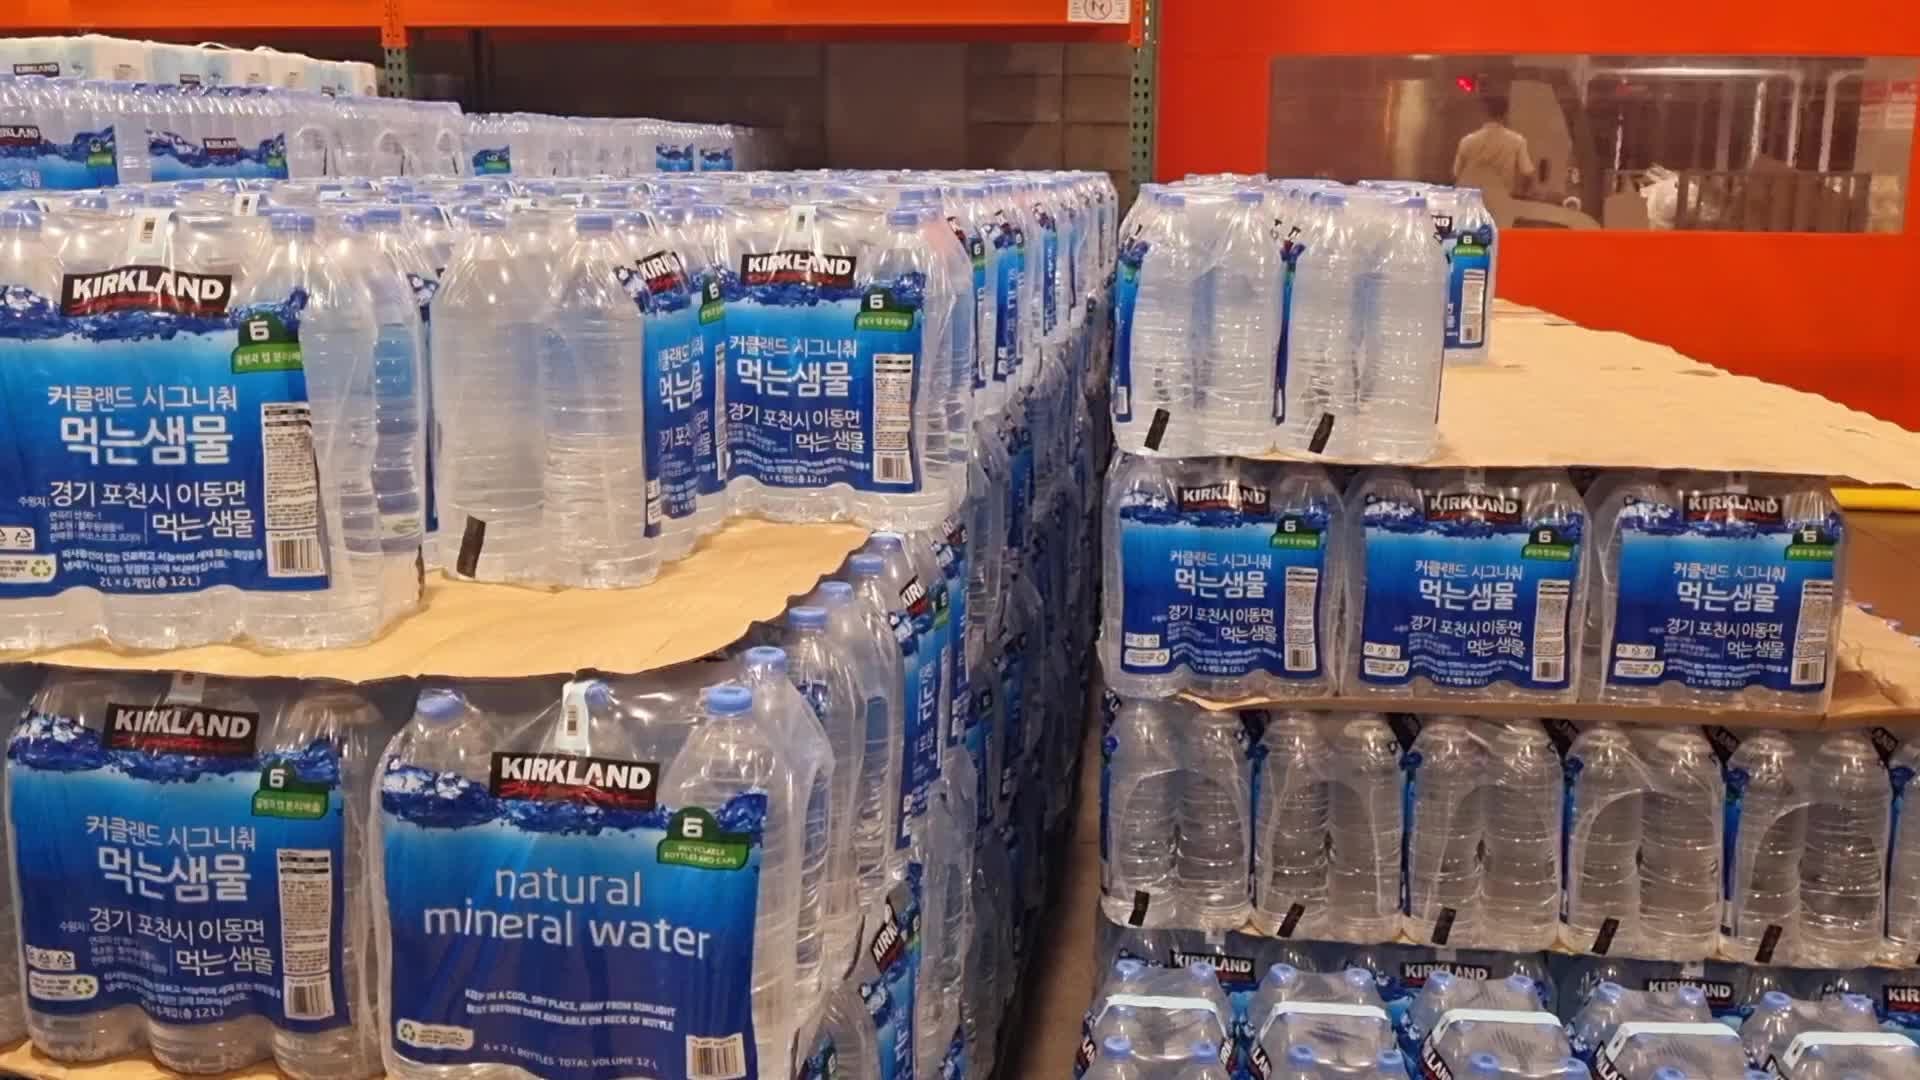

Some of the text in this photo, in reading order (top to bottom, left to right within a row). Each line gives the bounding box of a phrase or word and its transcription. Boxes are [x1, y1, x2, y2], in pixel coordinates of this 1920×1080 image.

[72, 269, 224, 300] KIRKLAND
[709, 282, 719, 299] 6
[869, 294, 884, 309] 6
[249, 320, 270, 341] 6
[735, 358, 854, 398] 먹는샘물
[47, 384, 237, 413] 커클랜드 시그니춰
[728, 402, 861, 431] 경기 포천시 이동면
[60, 414, 234, 467] 먹는샘물
[50, 480, 95, 508] 경기
[100, 482, 171, 511] 포천시
[176, 479, 246, 508] 이동면
[1430, 495, 1518, 514] KIRKLAND
[1687, 495, 1779, 514] KIRKLAND
[1284, 520, 1296, 532] 6
[1538, 530, 1551, 543] 6
[1803, 530, 1817, 543] 6
[1174, 568, 1268, 598] 먹는샘물
[1418, 578, 1518, 611] 먹는샘물
[1676, 580, 1780, 613] 먹는샘물
[1168, 604, 1193, 620] 경기
[1195, 607, 1235, 624] 포천시
[1235, 607, 1274, 624] 이동면
[1410, 615, 1437, 632] 경기
[1439, 619, 1480, 638] 포천시
[1481, 619, 1523, 638] 이동면
[1666, 618, 1694, 636] 경기
[1696, 620, 1740, 639] 포천시
[1742, 622, 1784, 640] 이동면
[114, 707, 251, 740] KIRKLAND
[269, 767, 285, 789] 6
[501, 756, 652, 791] KIRKLAND
[86, 815, 257, 852] 커클랜드 시그니춰
[683, 817, 703, 838] 6
[98, 846, 252, 903] 먹는샘물
[495, 866, 641, 908] natural
[88, 907, 132, 935] 경기
[135, 913, 194, 946] 포천시
[199, 918, 265, 945] 이동면
[423, 898, 712, 960] mineral water
[606, 1000, 632, 1011] FROM
[559, 1057, 590, 1069] TOTAL
[591, 1057, 634, 1068] VOLUME
